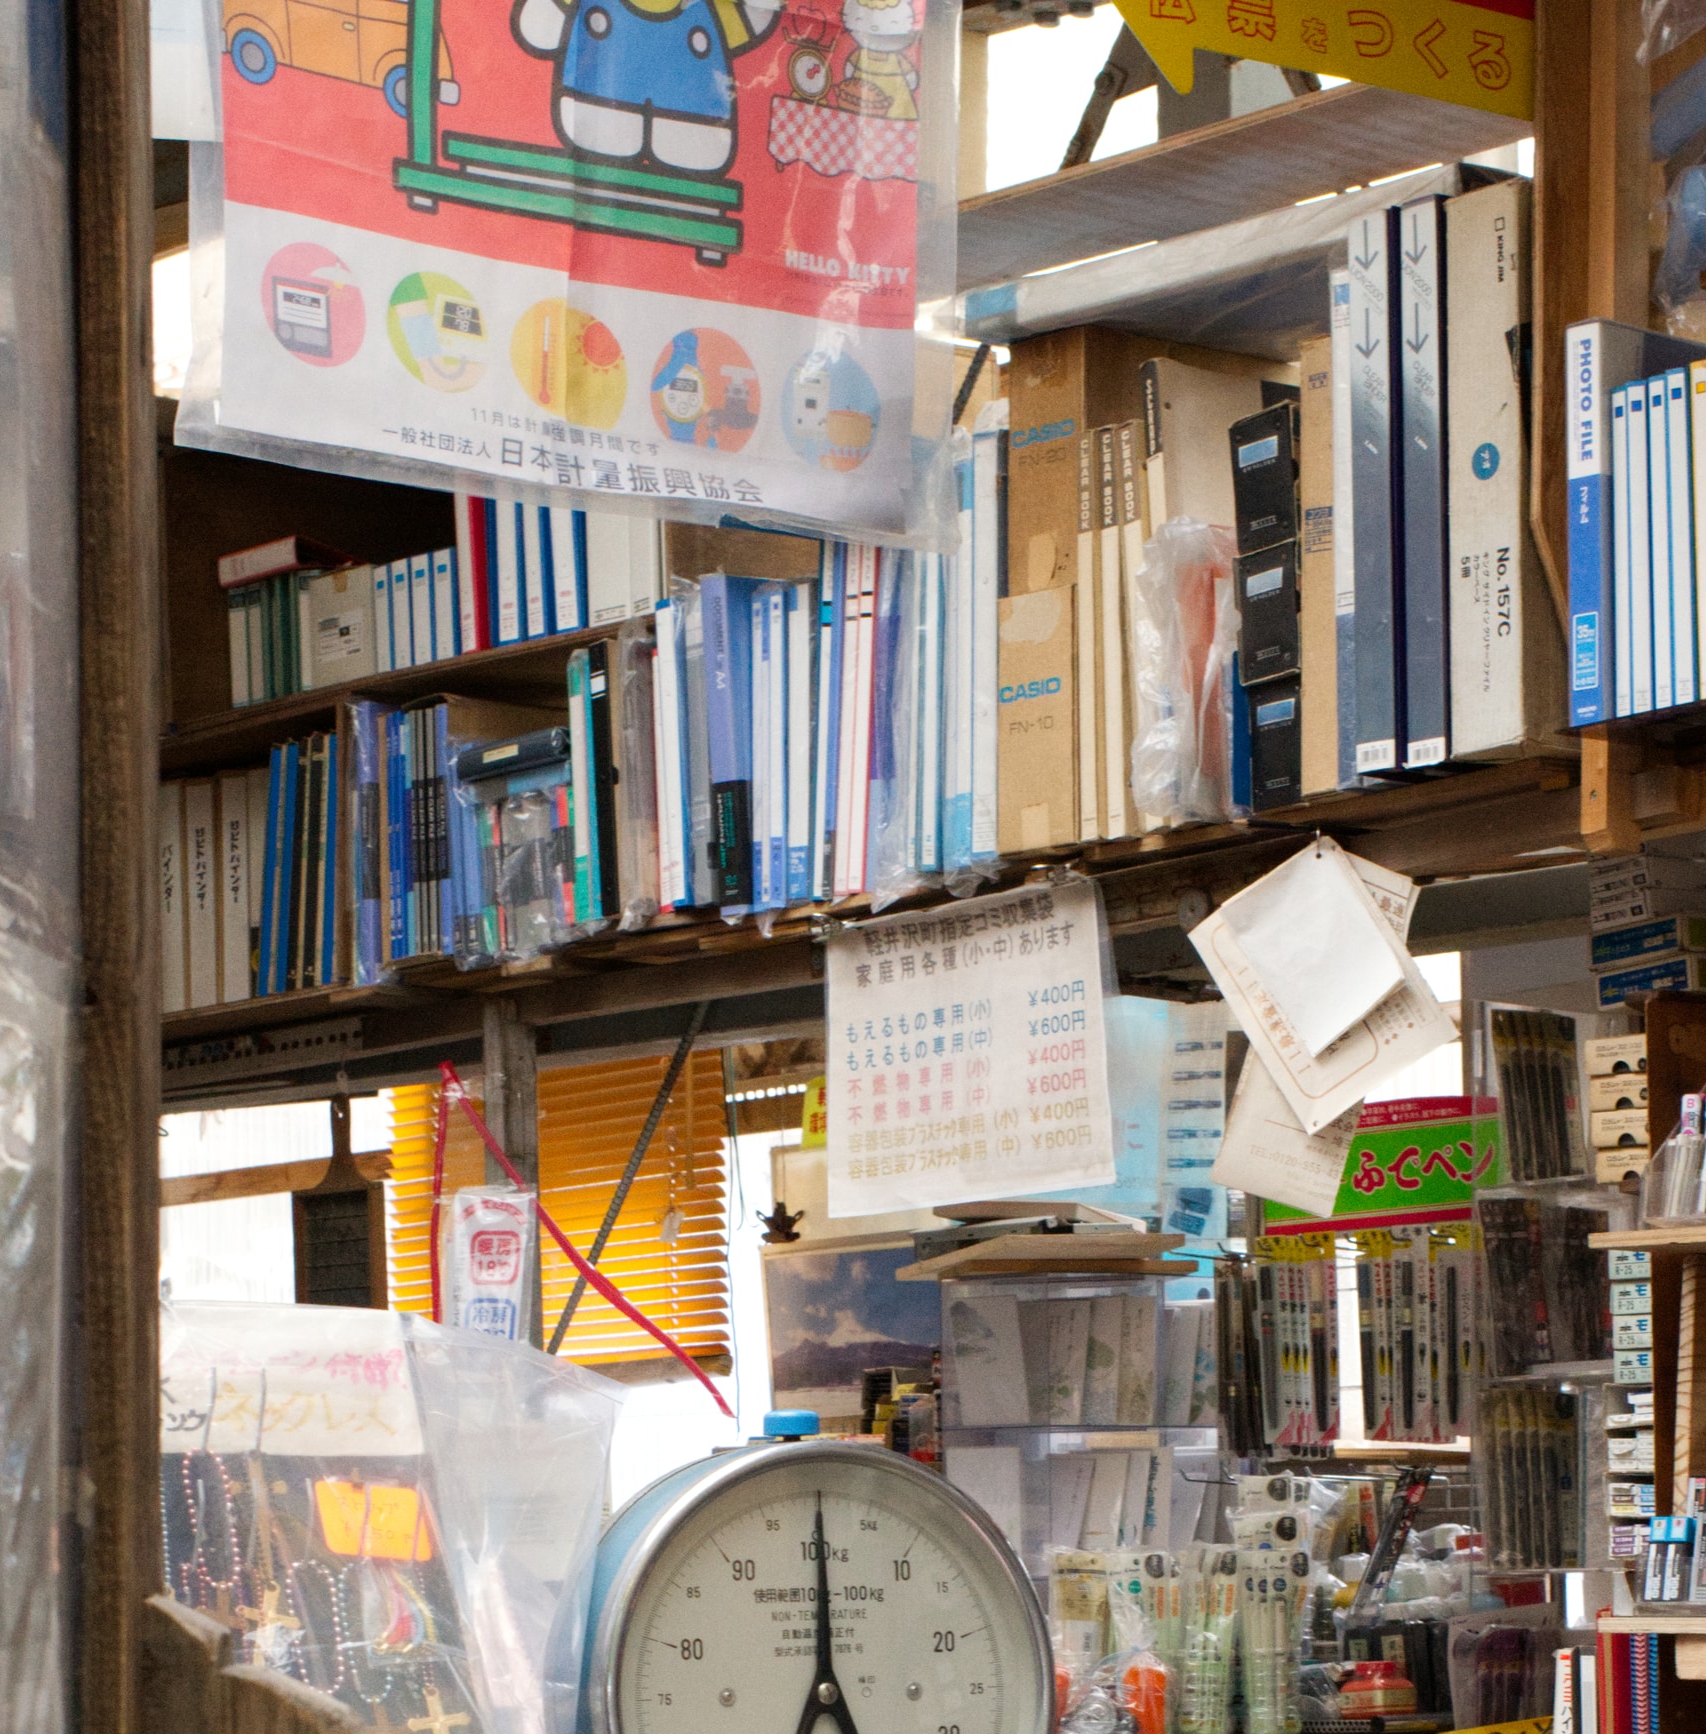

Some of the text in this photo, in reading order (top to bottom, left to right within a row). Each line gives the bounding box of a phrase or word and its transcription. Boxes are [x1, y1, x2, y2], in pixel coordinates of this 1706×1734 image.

[1496, 234, 1505, 263] KING
[785, 249, 841, 277] HELLO
[848, 262, 910, 285] KITTY
[1580, 337, 1594, 462] PHOTO FILE
[1010, 418, 1076, 449] CASIO
[382, 426, 766, 505] 一般社団法人 日本計量振興協会
[1120, 429, 1136, 521] CLEAR BOOK
[1080, 439, 1091, 530] CLEAR BOOK
[1101, 434, 1113, 526] CLEAR BOOK
[1496, 546, 1512, 638] No. 157C
[999, 676, 1062, 704] CASIO
[1009, 714, 1055, 736] FN-10
[1018, 920, 1075, 954] あります
[1027, 979, 1086, 1007] ¥400円
[1027, 1009, 1087, 1037] ¥600円
[1027, 1038, 1087, 1066] ¥400円
[1026, 1067, 1088, 1096] ¥600円
[1028, 1096, 1090, 1125] ¥400円
[1030, 1124, 1092, 1152] ¥600円
[1352, 1141, 1494, 1194] ふでペン
[765, 1519, 781, 1532] 95
[731, 1559, 756, 1582] 90
[892, 1559, 912, 1582] 10
[685, 1585, 702, 1599] 85
[935, 1581, 950, 1594] 15
[680, 1638, 704, 1661] 80
[932, 1630, 955, 1653] 20
[658, 1693, 672, 1707] 75
[970, 1683, 985, 1696] 25
